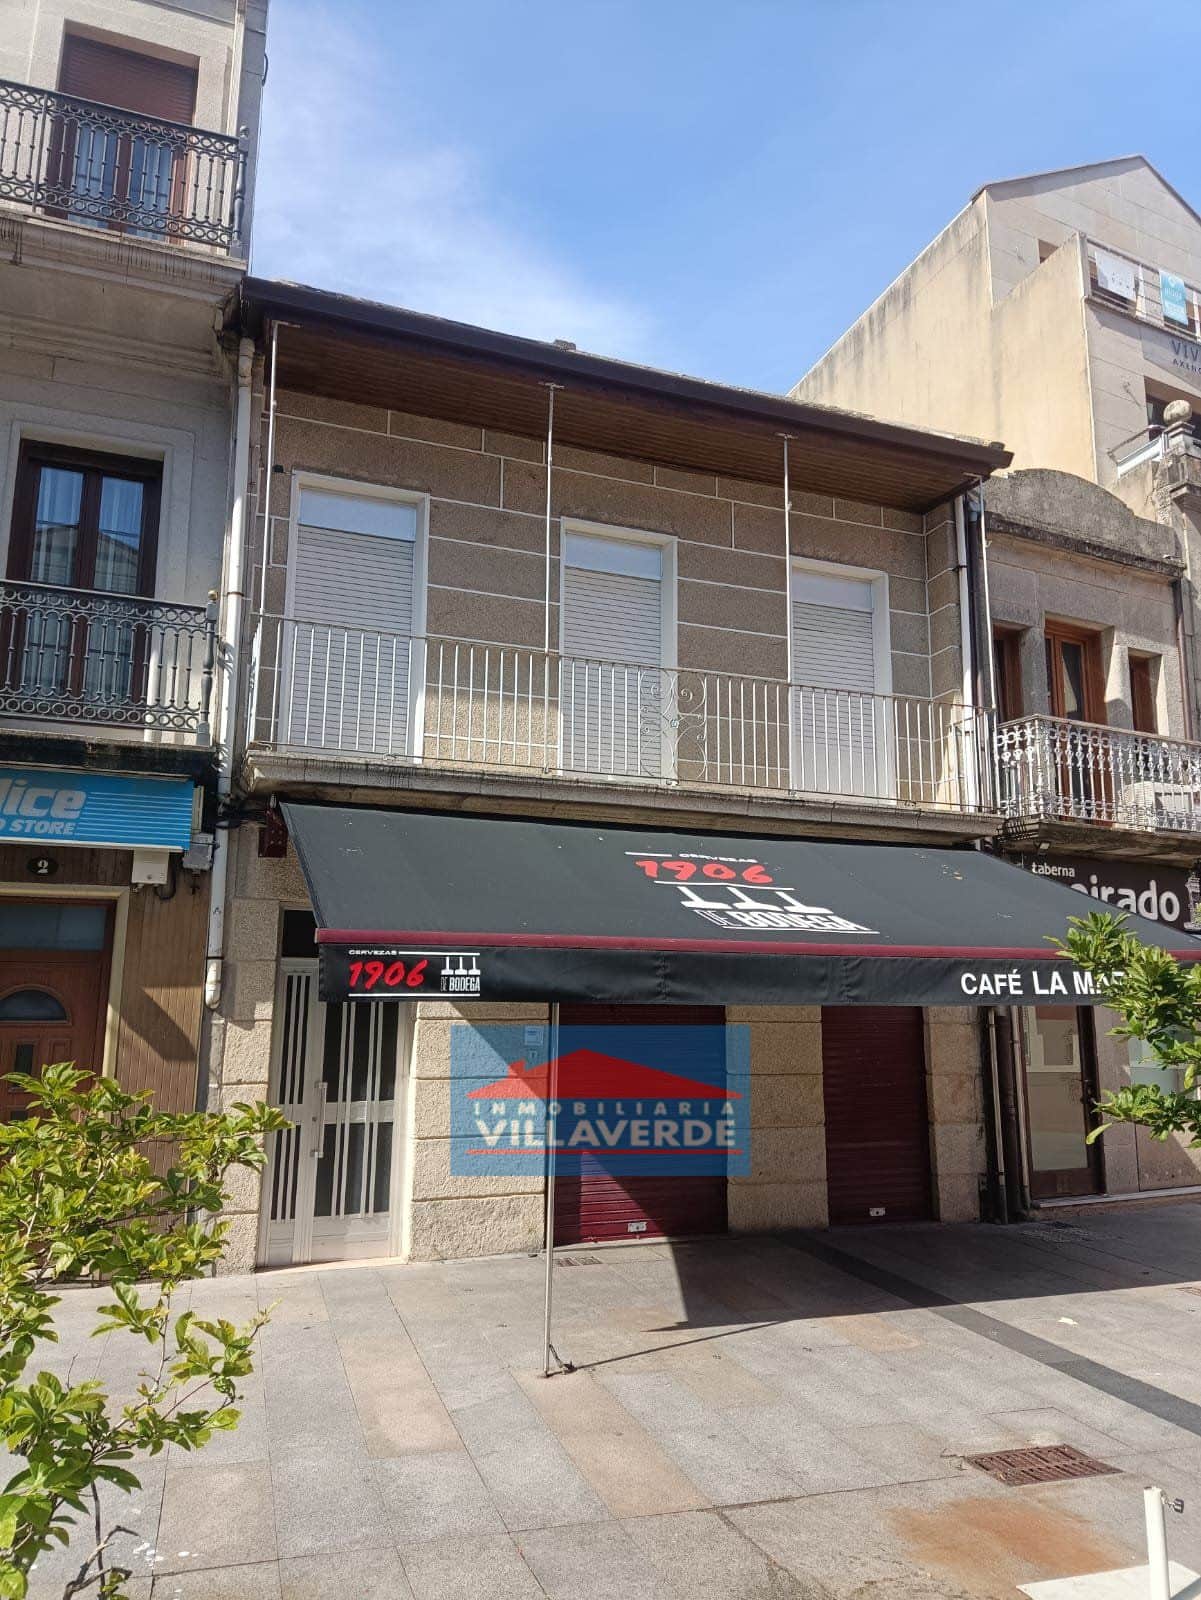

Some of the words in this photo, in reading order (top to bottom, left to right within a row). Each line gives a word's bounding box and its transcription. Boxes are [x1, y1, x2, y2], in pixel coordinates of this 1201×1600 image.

[9, 819, 76, 835] STORE
[37, 860, 48, 874] 2
[635, 860, 773, 884] 1906
[1031, 862, 1076, 878] taberna
[726, 911, 872, 930] BODEGA
[349, 959, 428, 990] 1906
[961, 969, 1024, 995] CAFÉ
[1032, 971, 1068, 995] LA
[440, 976, 448, 992] DE
[449, 976, 481, 992] BODEGA
